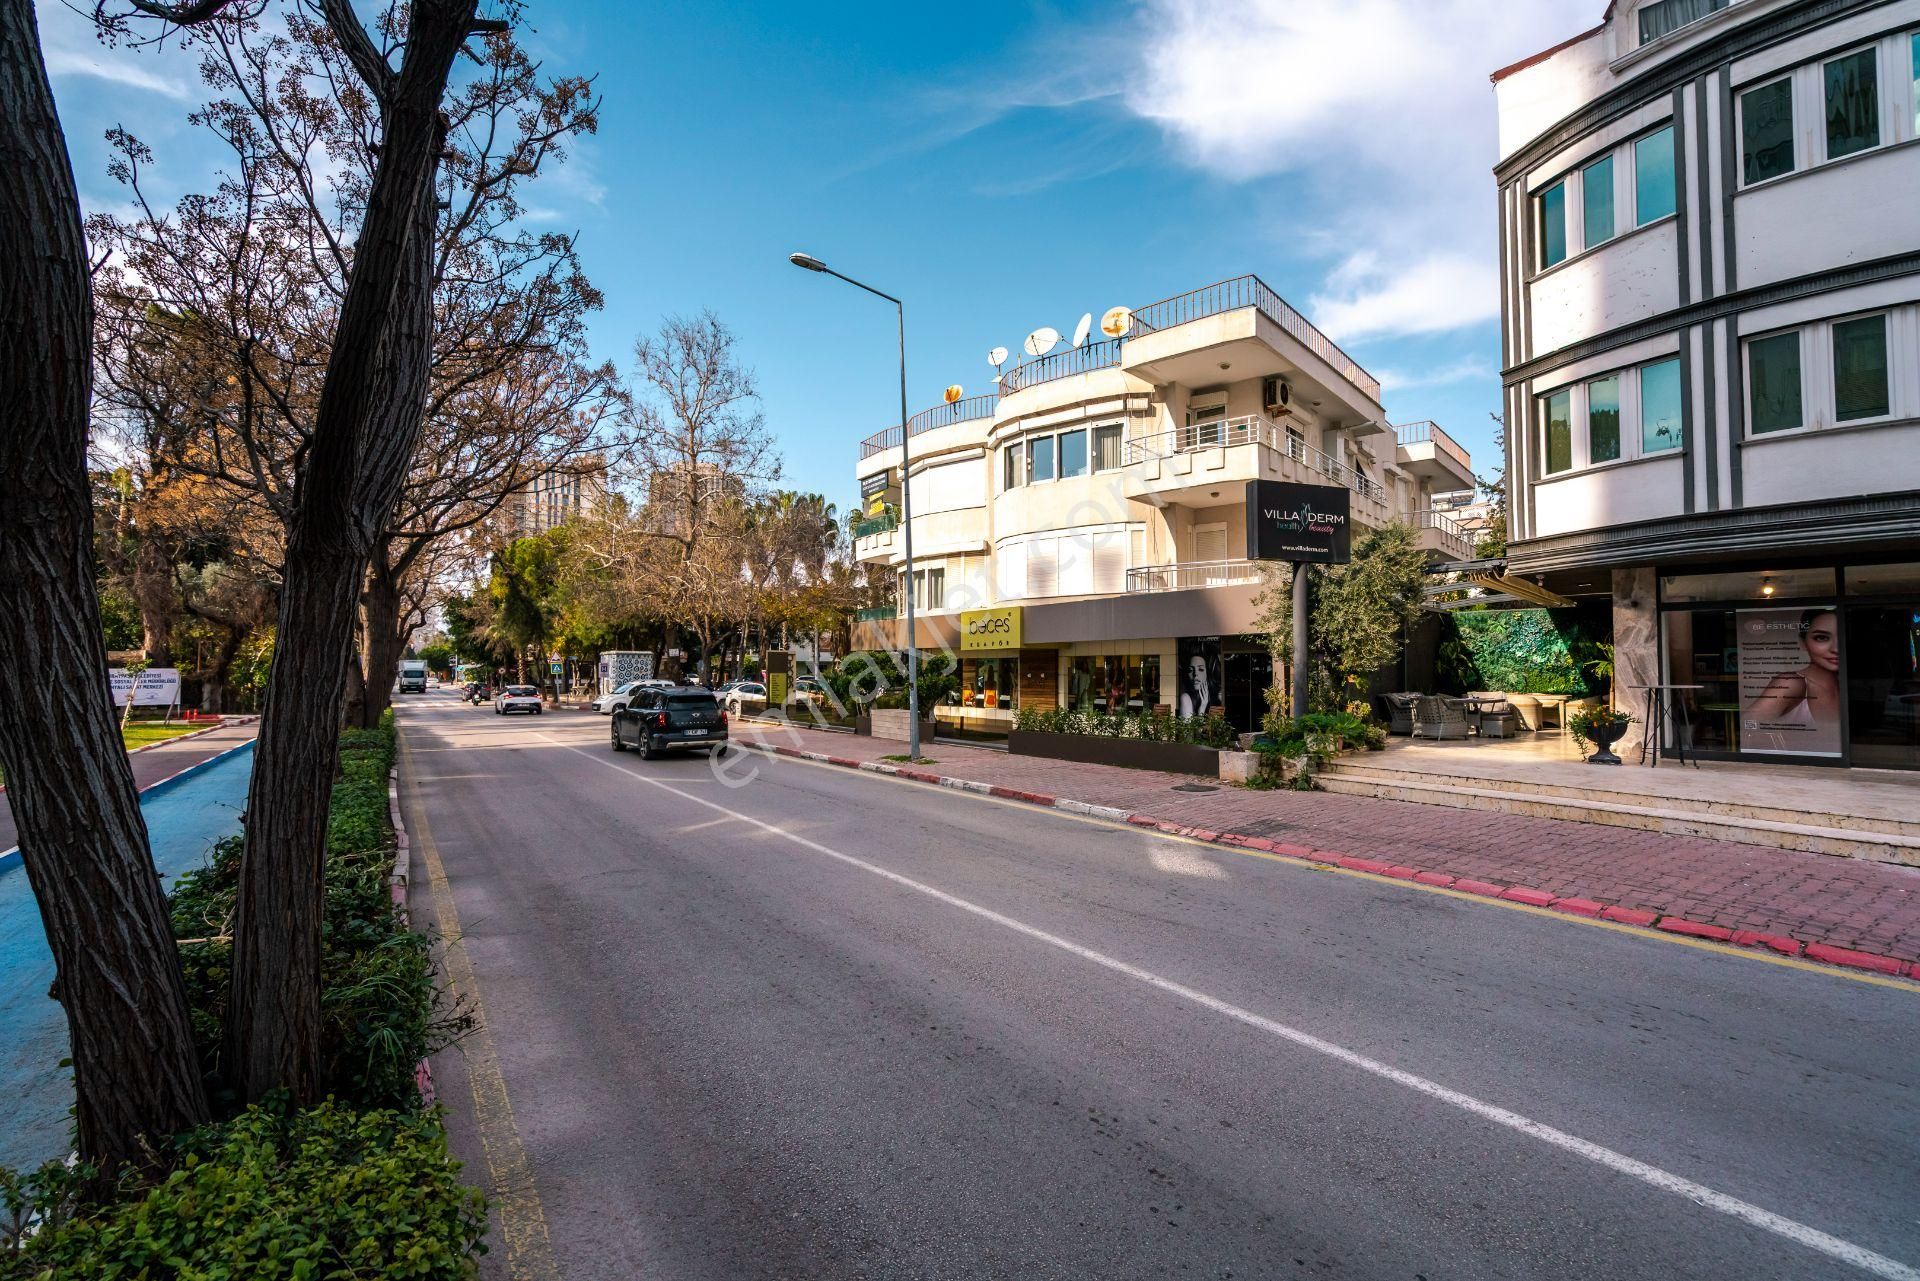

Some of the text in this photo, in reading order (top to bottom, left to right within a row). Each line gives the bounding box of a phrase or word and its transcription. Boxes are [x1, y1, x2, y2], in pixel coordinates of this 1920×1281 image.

[1264, 509, 1344, 525] VILLA DERM
[1276, 521, 1335, 535] health beauty
[1281, 545, 1329, 553] www.villaderm.com
